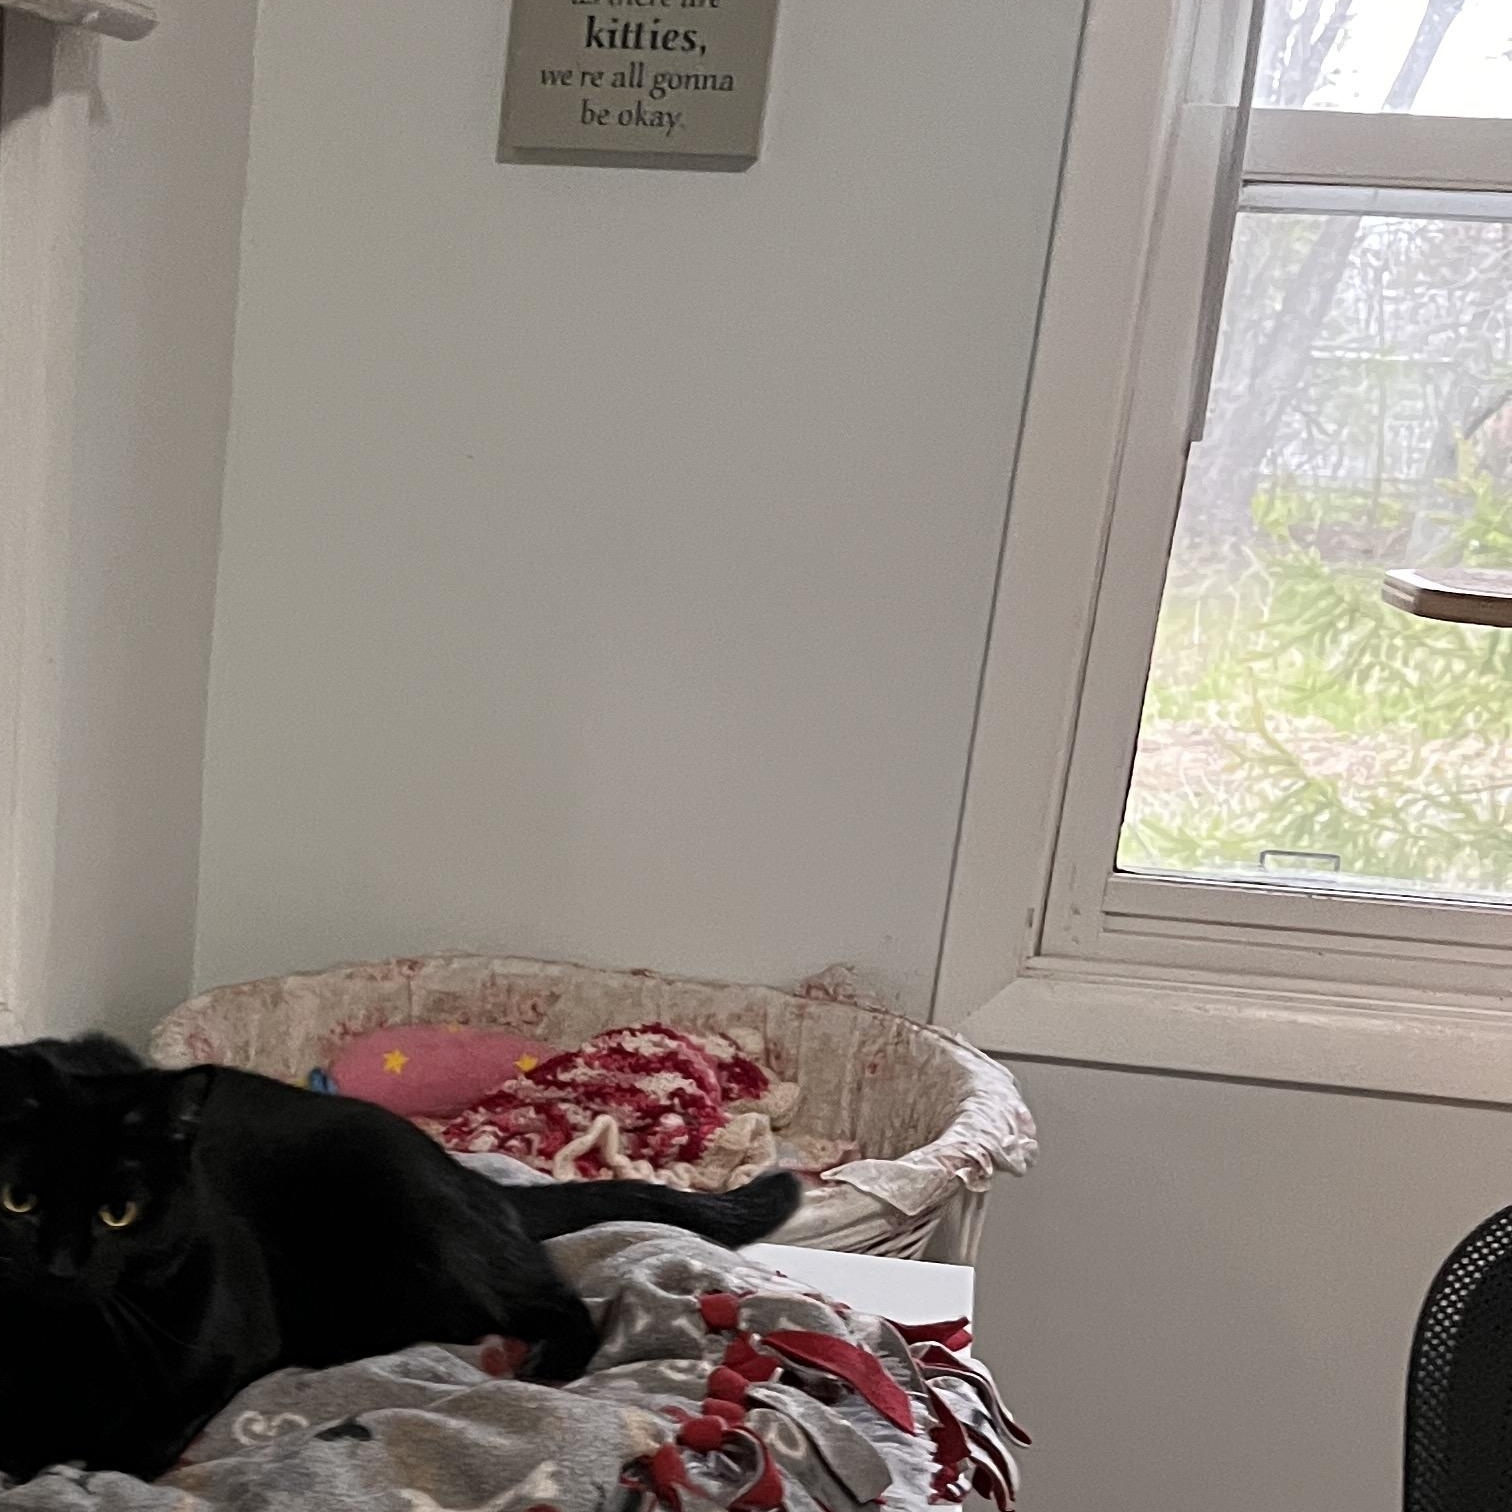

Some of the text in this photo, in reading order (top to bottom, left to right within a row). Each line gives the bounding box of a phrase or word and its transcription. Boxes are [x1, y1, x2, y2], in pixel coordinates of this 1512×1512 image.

[585, 15, 707, 56] kitties,
[540, 61, 735, 100] we're all gonna
[581, 97, 686, 136] be okay.
